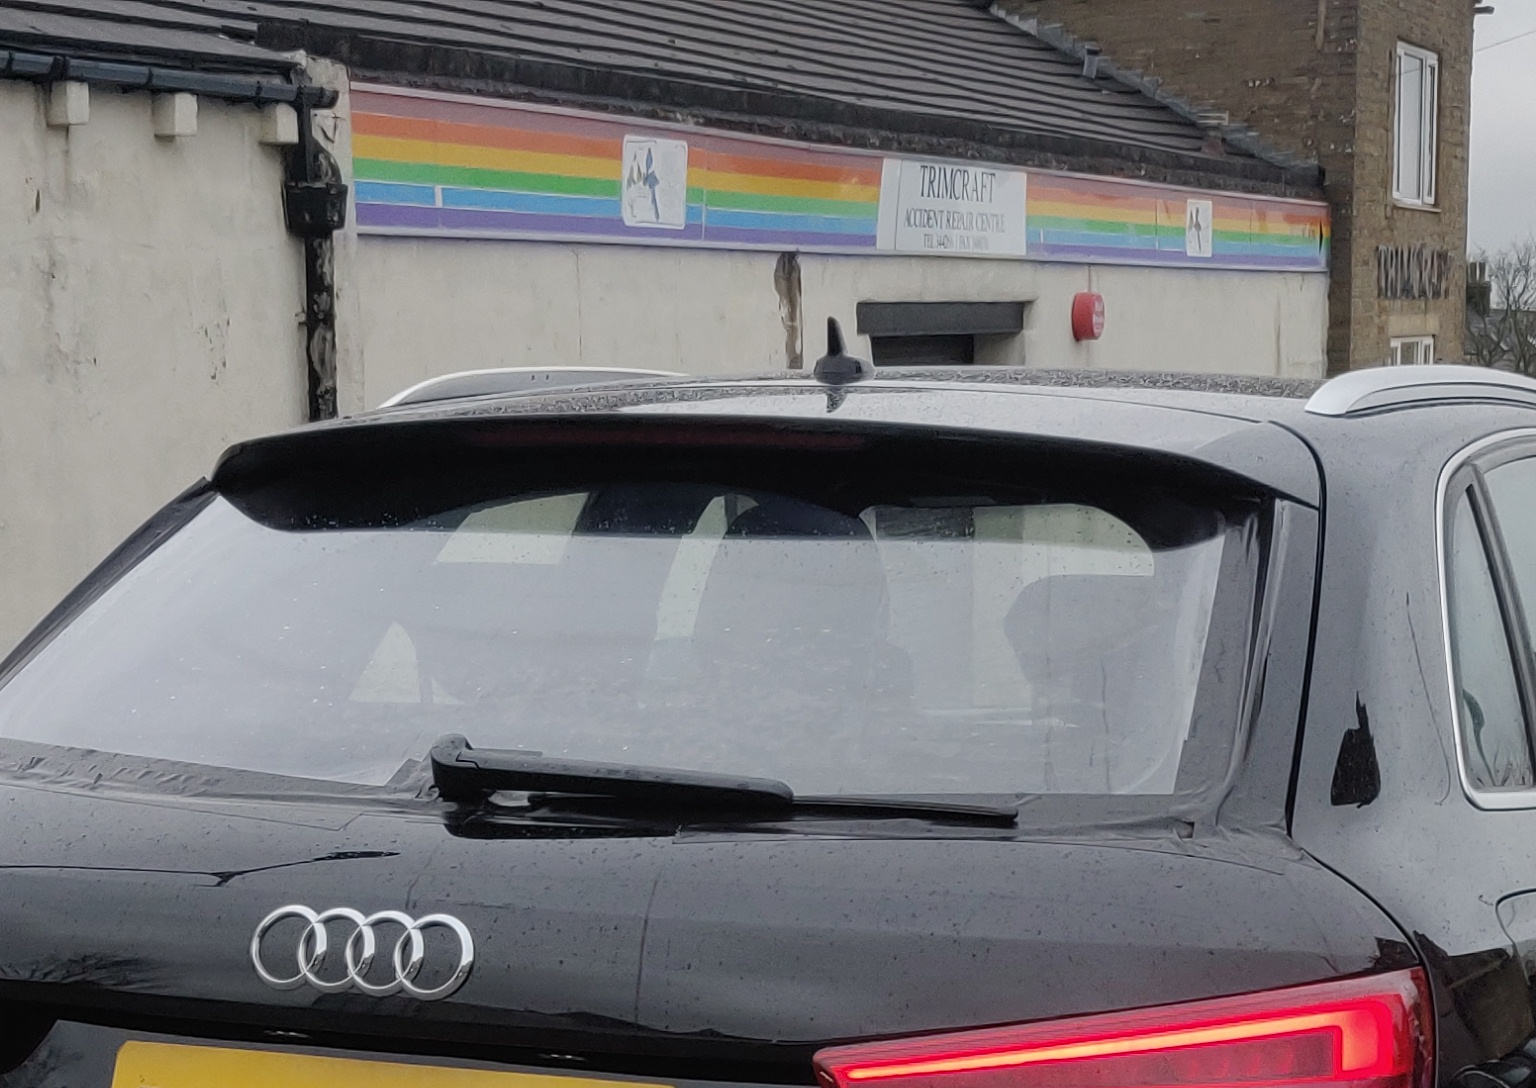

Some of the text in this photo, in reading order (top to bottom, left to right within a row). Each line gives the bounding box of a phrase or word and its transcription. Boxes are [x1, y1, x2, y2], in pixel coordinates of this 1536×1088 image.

[920, 165, 996, 203] TRIMCRAFT
[904, 207, 1005, 233] ACCIDENT REPAIR CENTRE
